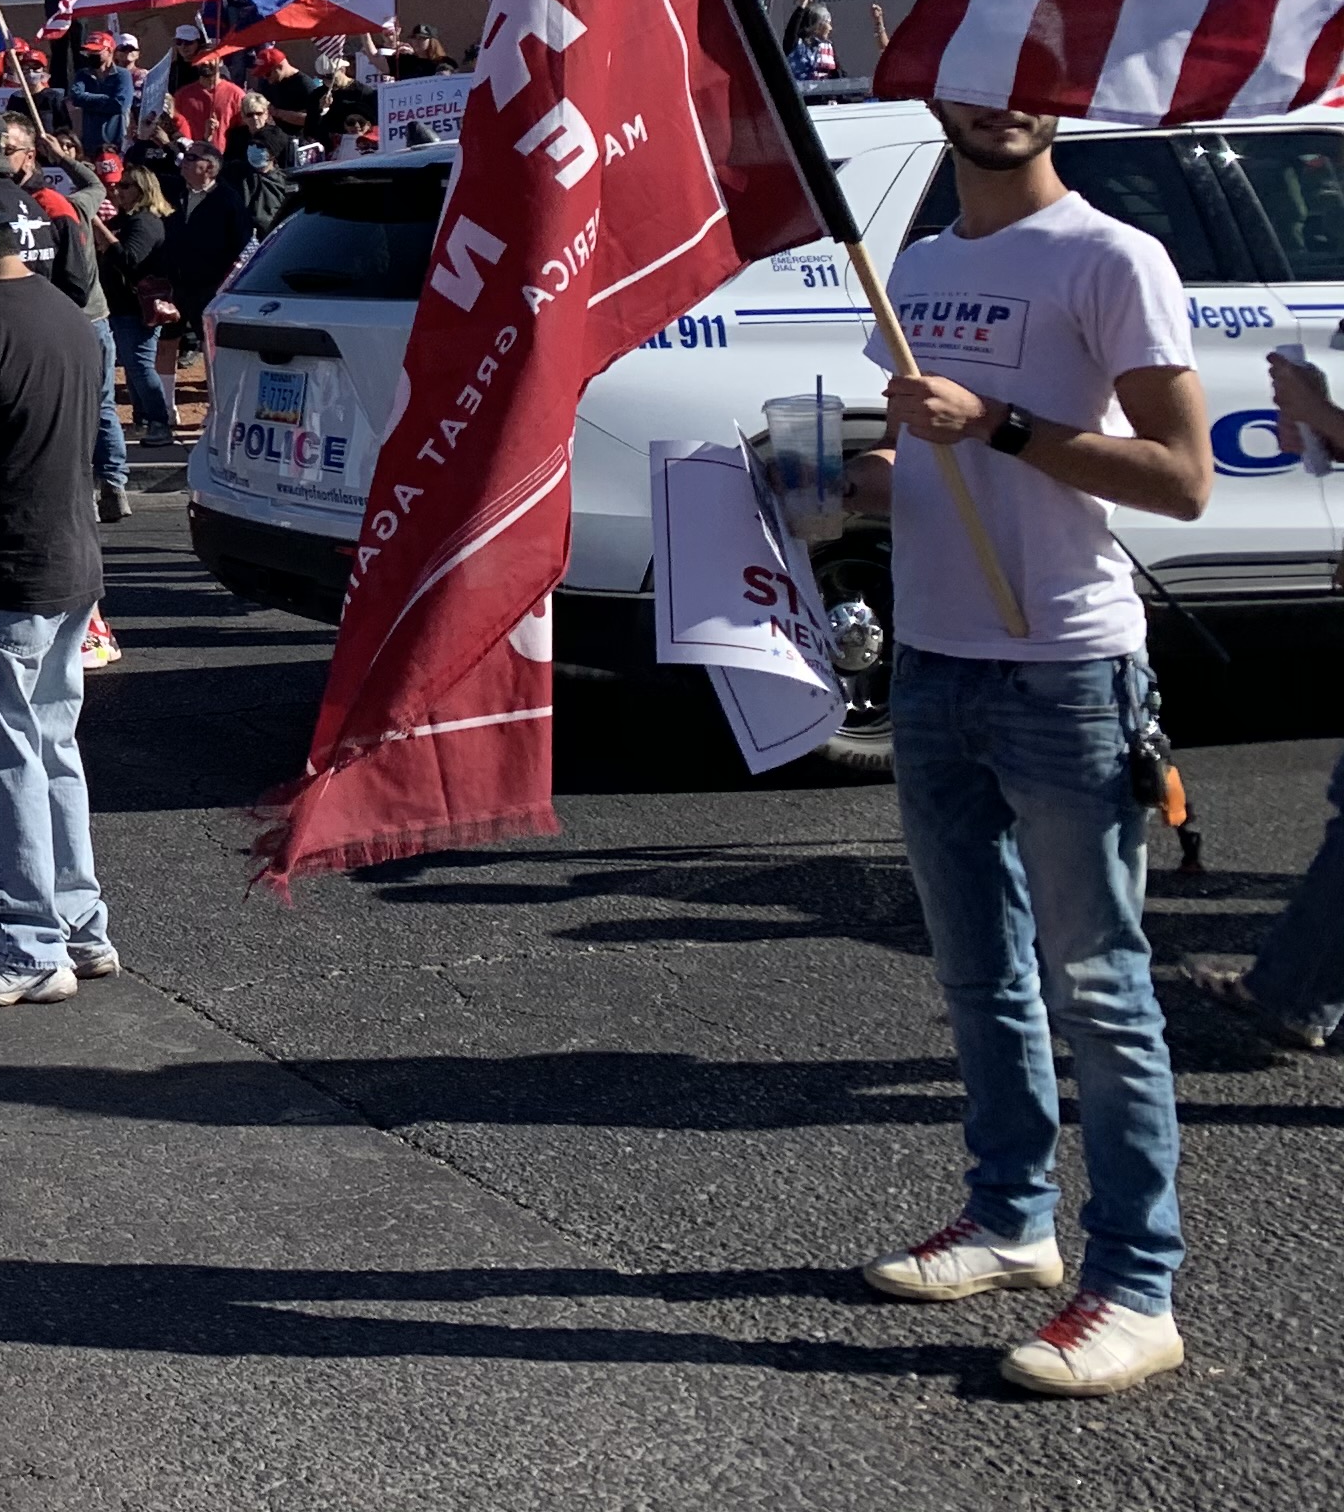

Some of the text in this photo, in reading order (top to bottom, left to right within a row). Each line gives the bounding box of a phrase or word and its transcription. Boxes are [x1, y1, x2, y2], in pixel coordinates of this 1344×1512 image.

[365, 74, 395, 84] STE
[389, 89, 462, 109] THIS IS A
[388, 102, 462, 124] PEACEFUL
[389, 116, 462, 141] PREST
[44, 174, 64, 185] OP
[770, 254, 833, 265] EMERGENCY
[773, 263, 796, 273] DIAL
[800, 264, 840, 288] 311
[899, 302, 1011, 325] TRUMP
[678, 315, 728, 349] 911
[902, 324, 991, 342] ENCE
[231, 422, 348, 474] POLICE
